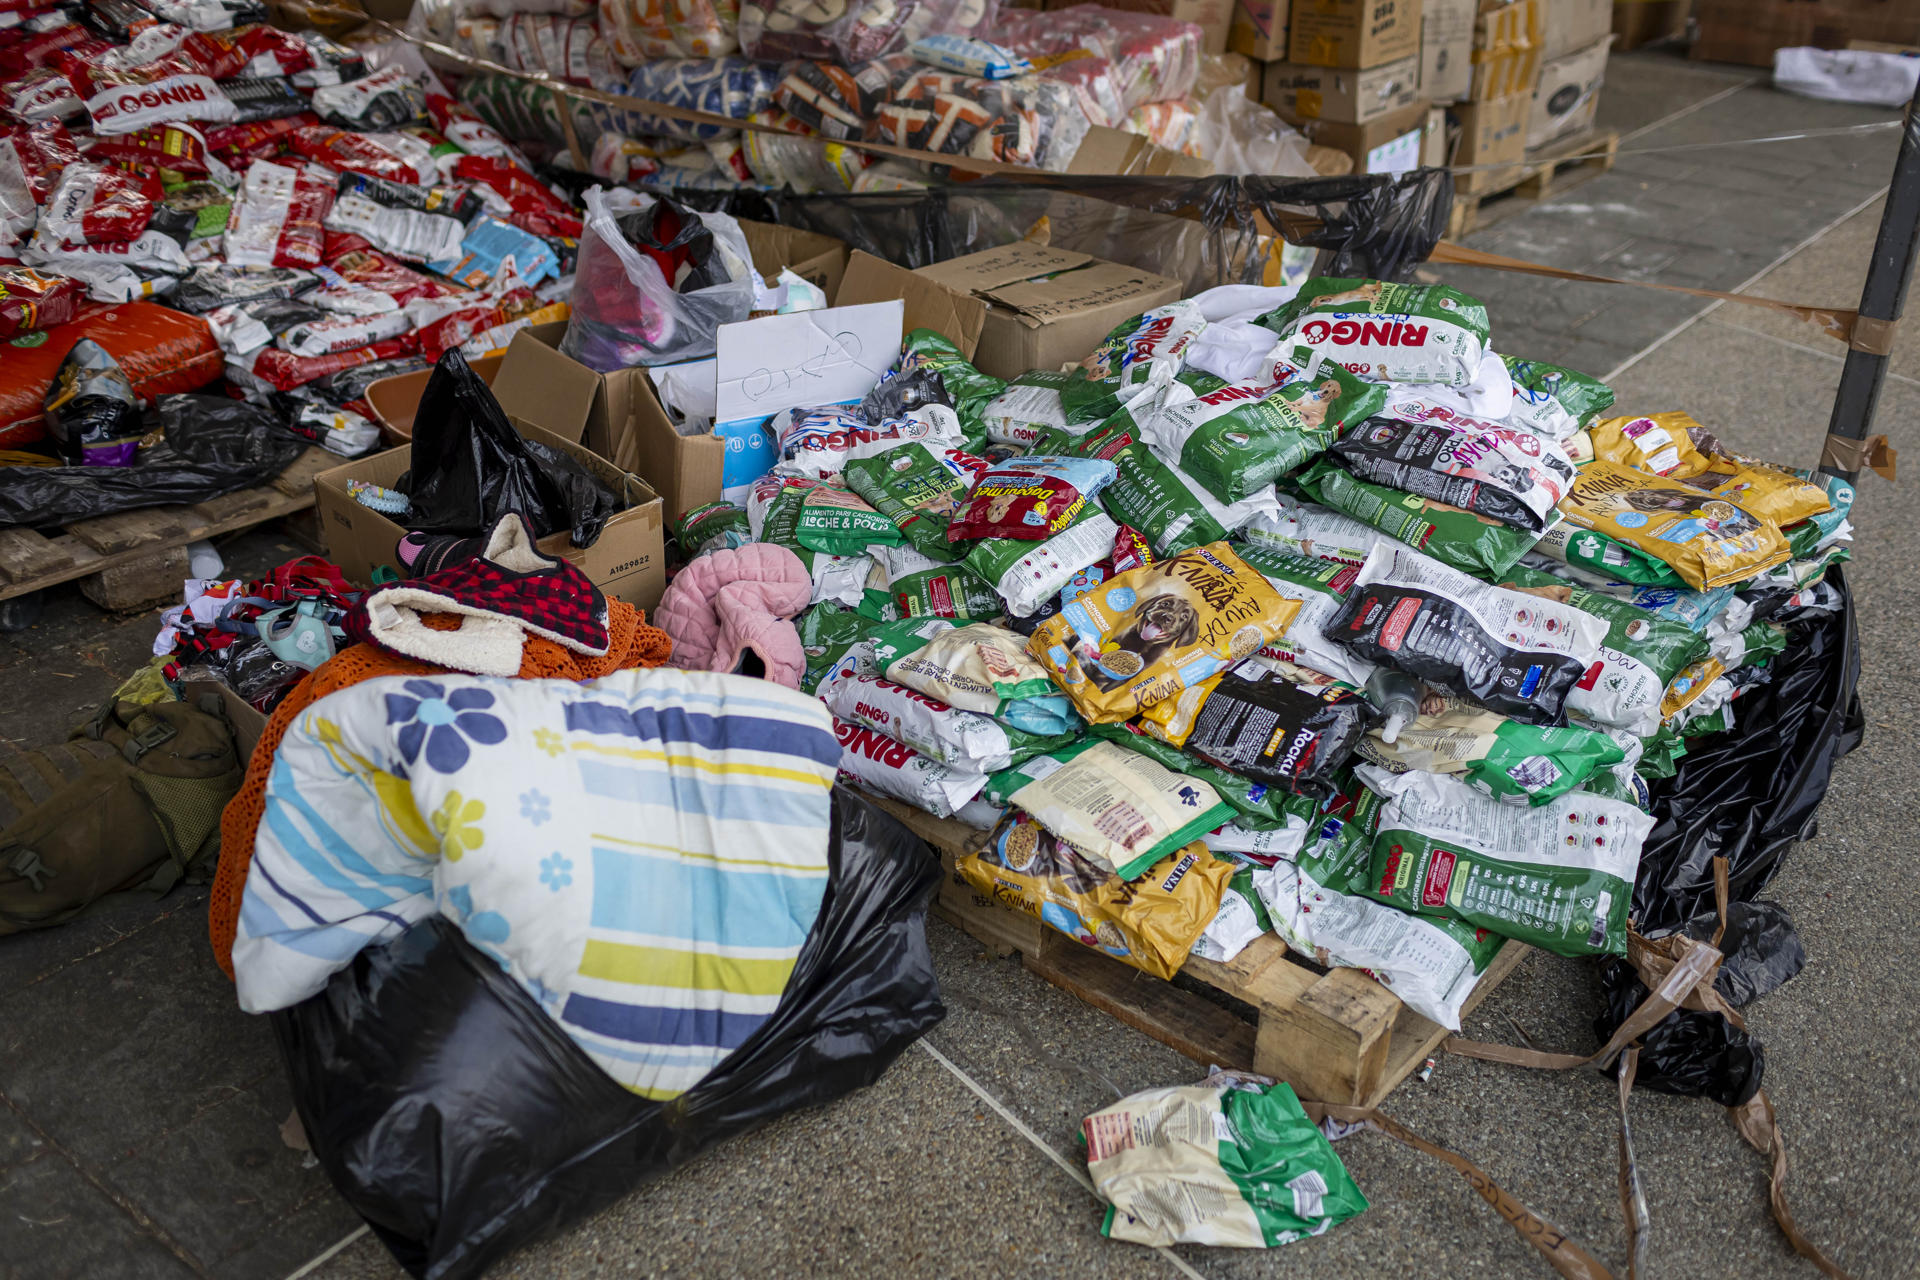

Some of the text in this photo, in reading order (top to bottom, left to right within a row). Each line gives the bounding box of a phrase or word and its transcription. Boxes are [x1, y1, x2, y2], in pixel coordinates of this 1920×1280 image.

[118, 83, 207, 113] RINGO
[1133, 316, 1175, 363] RINGO
[1301, 320, 1429, 347] RINGO
[1268, 394, 1301, 428] ORIGIN
[909, 478, 960, 505] ORIGINAL
[972, 486, 1056, 499] Dogourmet
[842, 517, 851, 528] &
[1049, 494, 1087, 533] Dogourmet
[1203, 551, 1235, 576] PURINA
[1256, 647, 1295, 662] RING
[854, 701, 890, 725] RINGO
[833, 718, 918, 770] RING
[1163, 854, 1195, 892] PURINA
[1379, 844, 1404, 896] RINGO
[1398, 855, 1411, 886] ORIGINAL
[1412, 867, 1424, 911] CACHORROS
